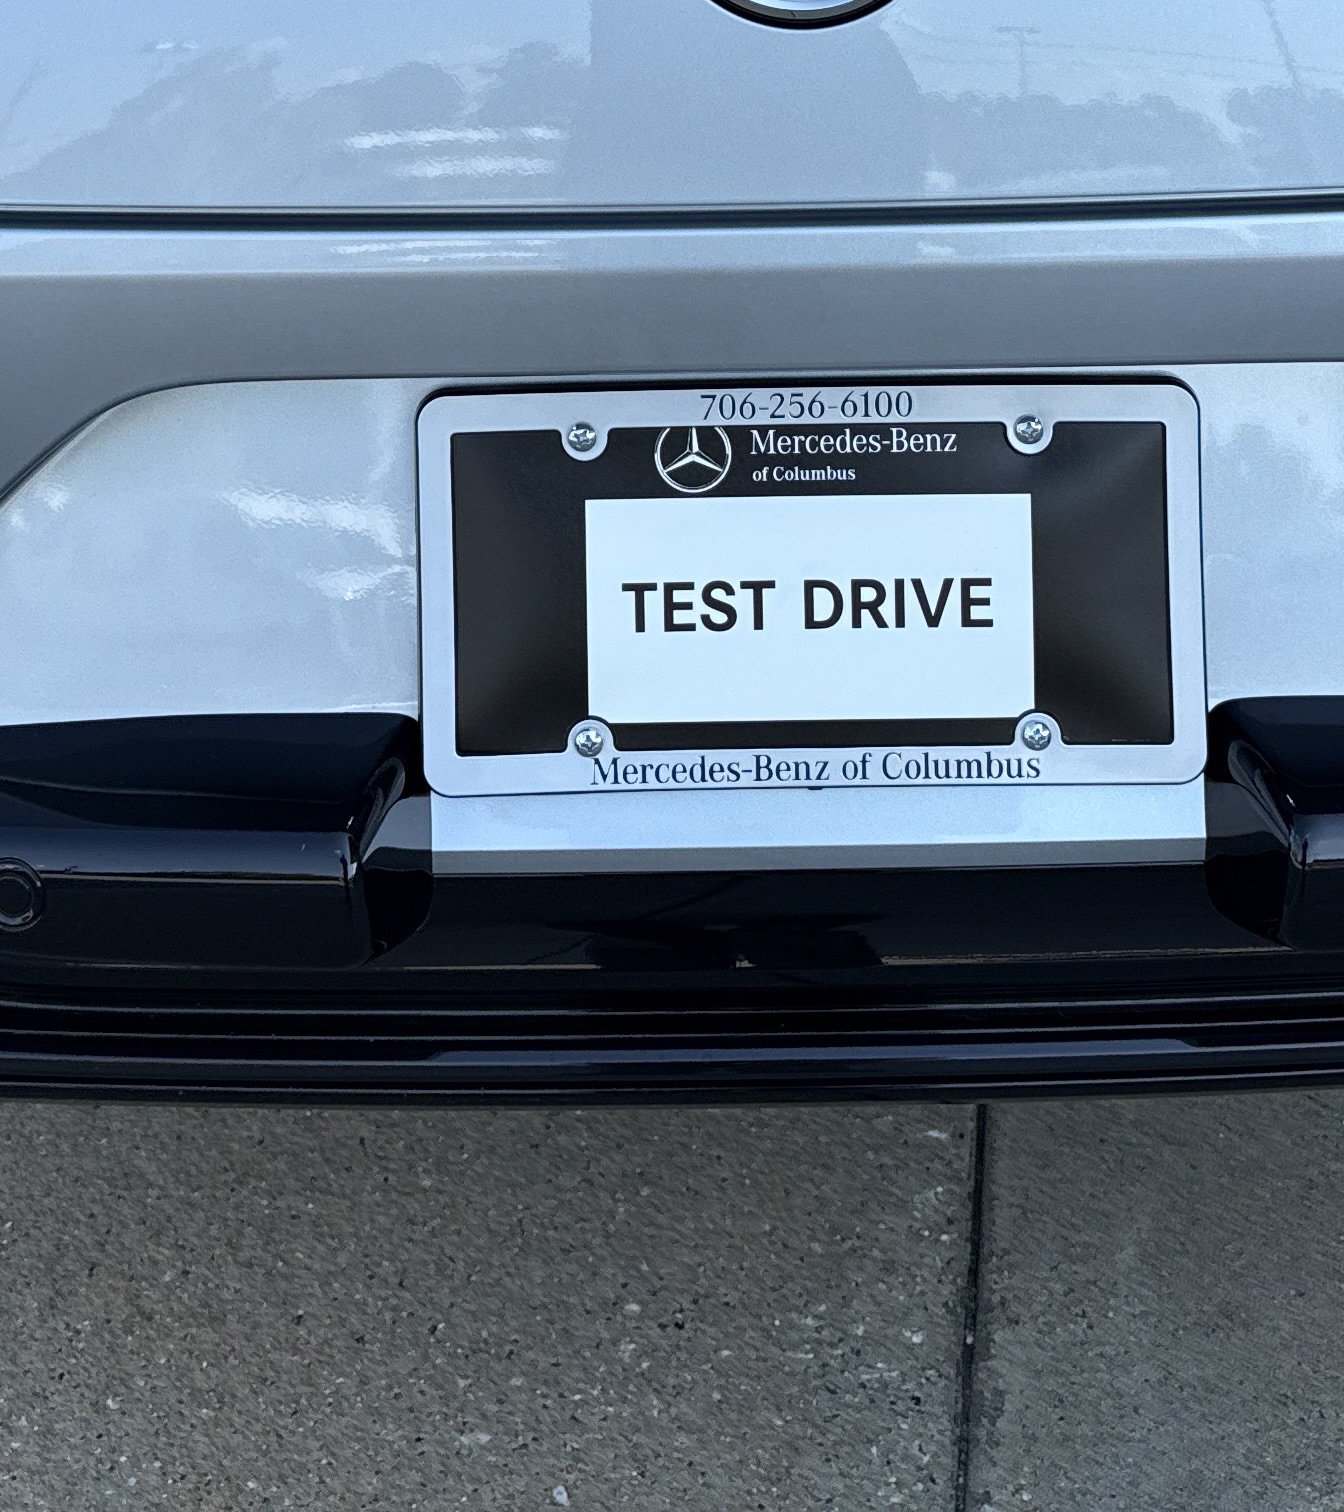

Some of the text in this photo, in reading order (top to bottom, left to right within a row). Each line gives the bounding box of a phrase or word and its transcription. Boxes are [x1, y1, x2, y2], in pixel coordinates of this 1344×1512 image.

[700, 390, 914, 420] 706-256-6100
[749, 427, 958, 455] Mercedes-Benz
[752, 465, 856, 482] of Columbus
[621, 577, 994, 633] TEST DRIVE
[590, 752, 1042, 786] Mercedes-Benz of Columbus
